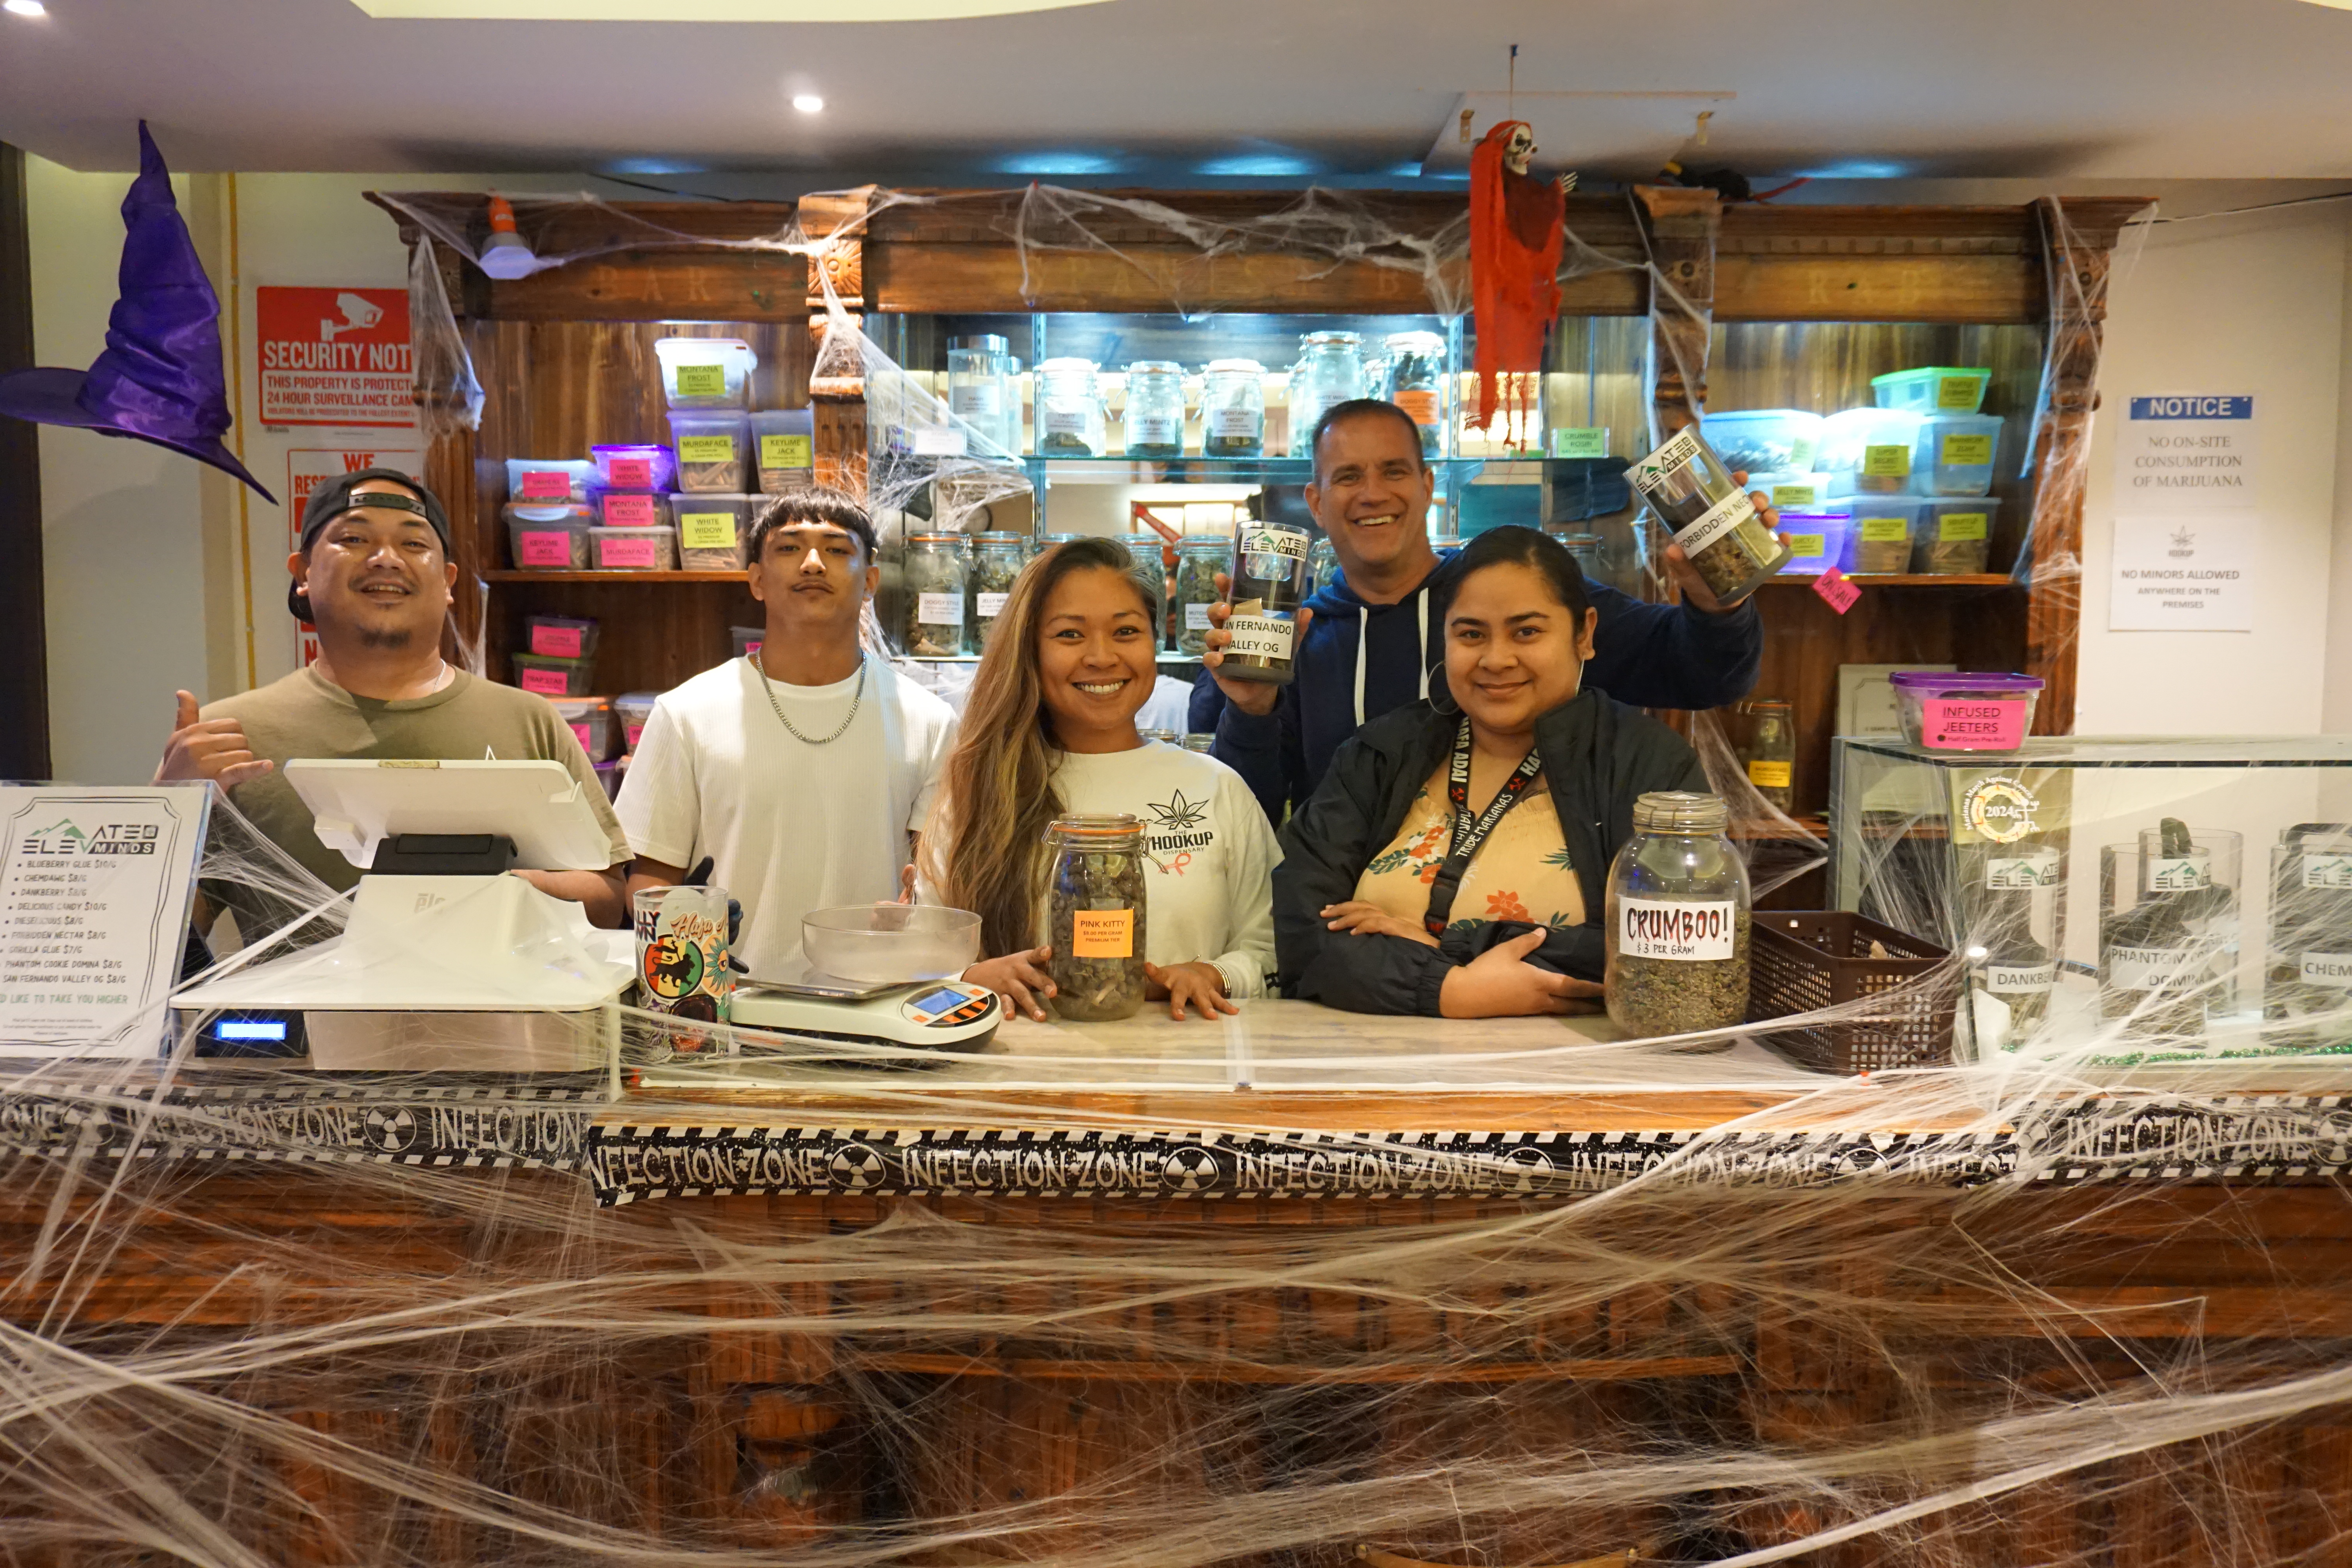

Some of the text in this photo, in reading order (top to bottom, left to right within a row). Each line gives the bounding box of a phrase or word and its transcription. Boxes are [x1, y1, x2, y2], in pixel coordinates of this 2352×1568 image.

[264, 341, 410, 370] SECURITY NOT
[267, 376, 412, 391] THIS PROPERTY IS PROTECT
[267, 392, 279, 404] 24
[283, 392, 310, 404] HOUR
[314, 393, 388, 406] SURVEILLANCE
[2150, 398, 2232, 416] NOTICE
[2149, 436, 2231, 448] NO ON-SITE
[343, 454, 374, 472] WE
[1667, 446, 1697, 470] MINDS
[2135, 455, 2242, 468] CONSUMPTION
[2134, 475, 2243, 488] OF MARIJUANA
[1679, 508, 1734, 550] FORBIDDEN
[1280, 547, 1305, 558] MINDS
[2122, 570, 2240, 580] NO MINORS ALLOWED
[2162, 601, 2205, 609] PREMISES
[1236, 621, 1291, 635] FERNANDO
[1227, 640, 1279, 653] VALLEY OG
[1943, 707, 2001, 718] INFUSED
[1943, 722, 1999, 733] JEETERS
[1452, 715, 1469, 783] HAFA ADAI
[1964, 775, 2034, 830] Marianas March Against Cancer
[1985, 806, 2015, 817] 2024
[1455, 793, 1513, 857] TRIBE MARIANAS
[1151, 831, 1214, 851] HOOKUP
[94, 843, 153, 853] MINDS
[1163, 847, 1205, 855] DISPENSARY
[84, 902, 107, 910] $10/G
[64, 916, 83, 925] $8/G
[1103, 920, 1125, 928] KITTY
[1627, 907, 1728, 944] CRUMBOO!
[87, 930, 107, 939] $8/G
[63, 945, 83, 954] $7/G
[1653, 944, 1695, 955] PER GRAM
[2112, 950, 2186, 964] PHANTOM
[103, 959, 122, 969] $8/G
[2305, 962, 2352, 976] CHEM
[107, 974, 127, 984] $8/G
[2149, 975, 2206, 986] DOMINA
[10, 994, 128, 1004] LIKE TO TAKE YOU HIGHER
[431, 1107, 581, 1153] INFECTION
[2065, 1114, 2314, 1162] INFECTION ZONE
[748, 1147, 831, 1186] ZONE
[903, 1147, 1070, 1189] INFECTION
[1077, 1147, 1160, 1189] ZONE
[1236, 1151, 1401, 1190] INFECTION
[1411, 1149, 1494, 1192] ZONE
